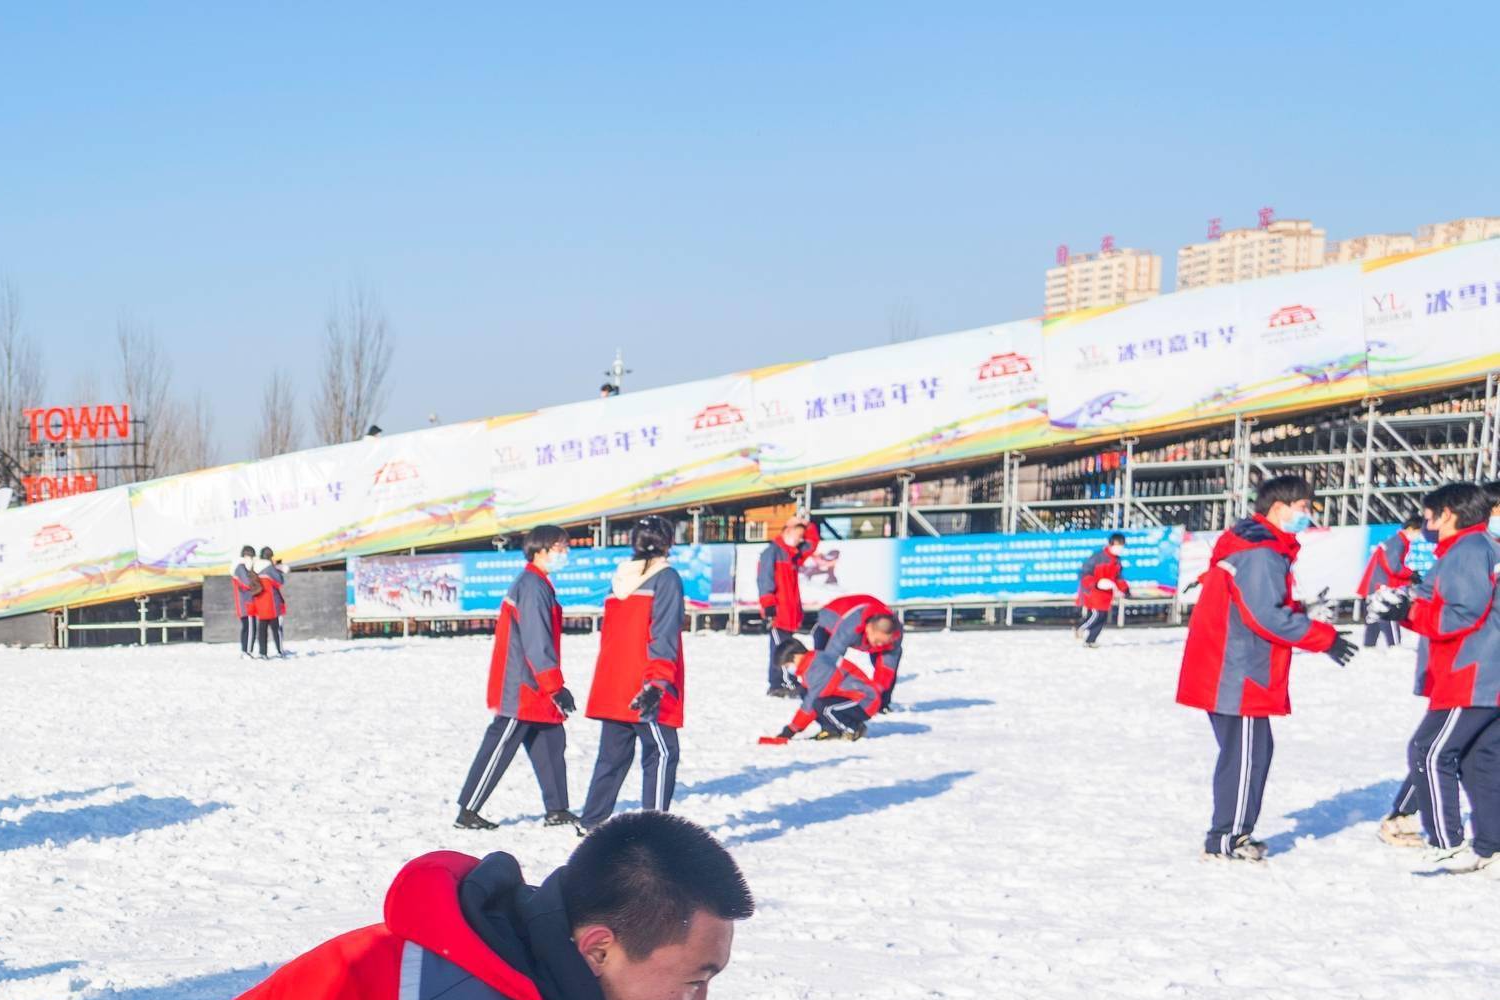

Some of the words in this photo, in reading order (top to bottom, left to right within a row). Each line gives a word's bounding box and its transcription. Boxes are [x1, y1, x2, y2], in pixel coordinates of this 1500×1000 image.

[1117, 326, 1235, 362] 冰雪嘉年华
[805, 377, 940, 420] 冰雪嘉年华
[23, 404, 130, 443] TOWN
[535, 426, 660, 466] 冰雪嘉年华
[21, 475, 98, 505] TOWN
